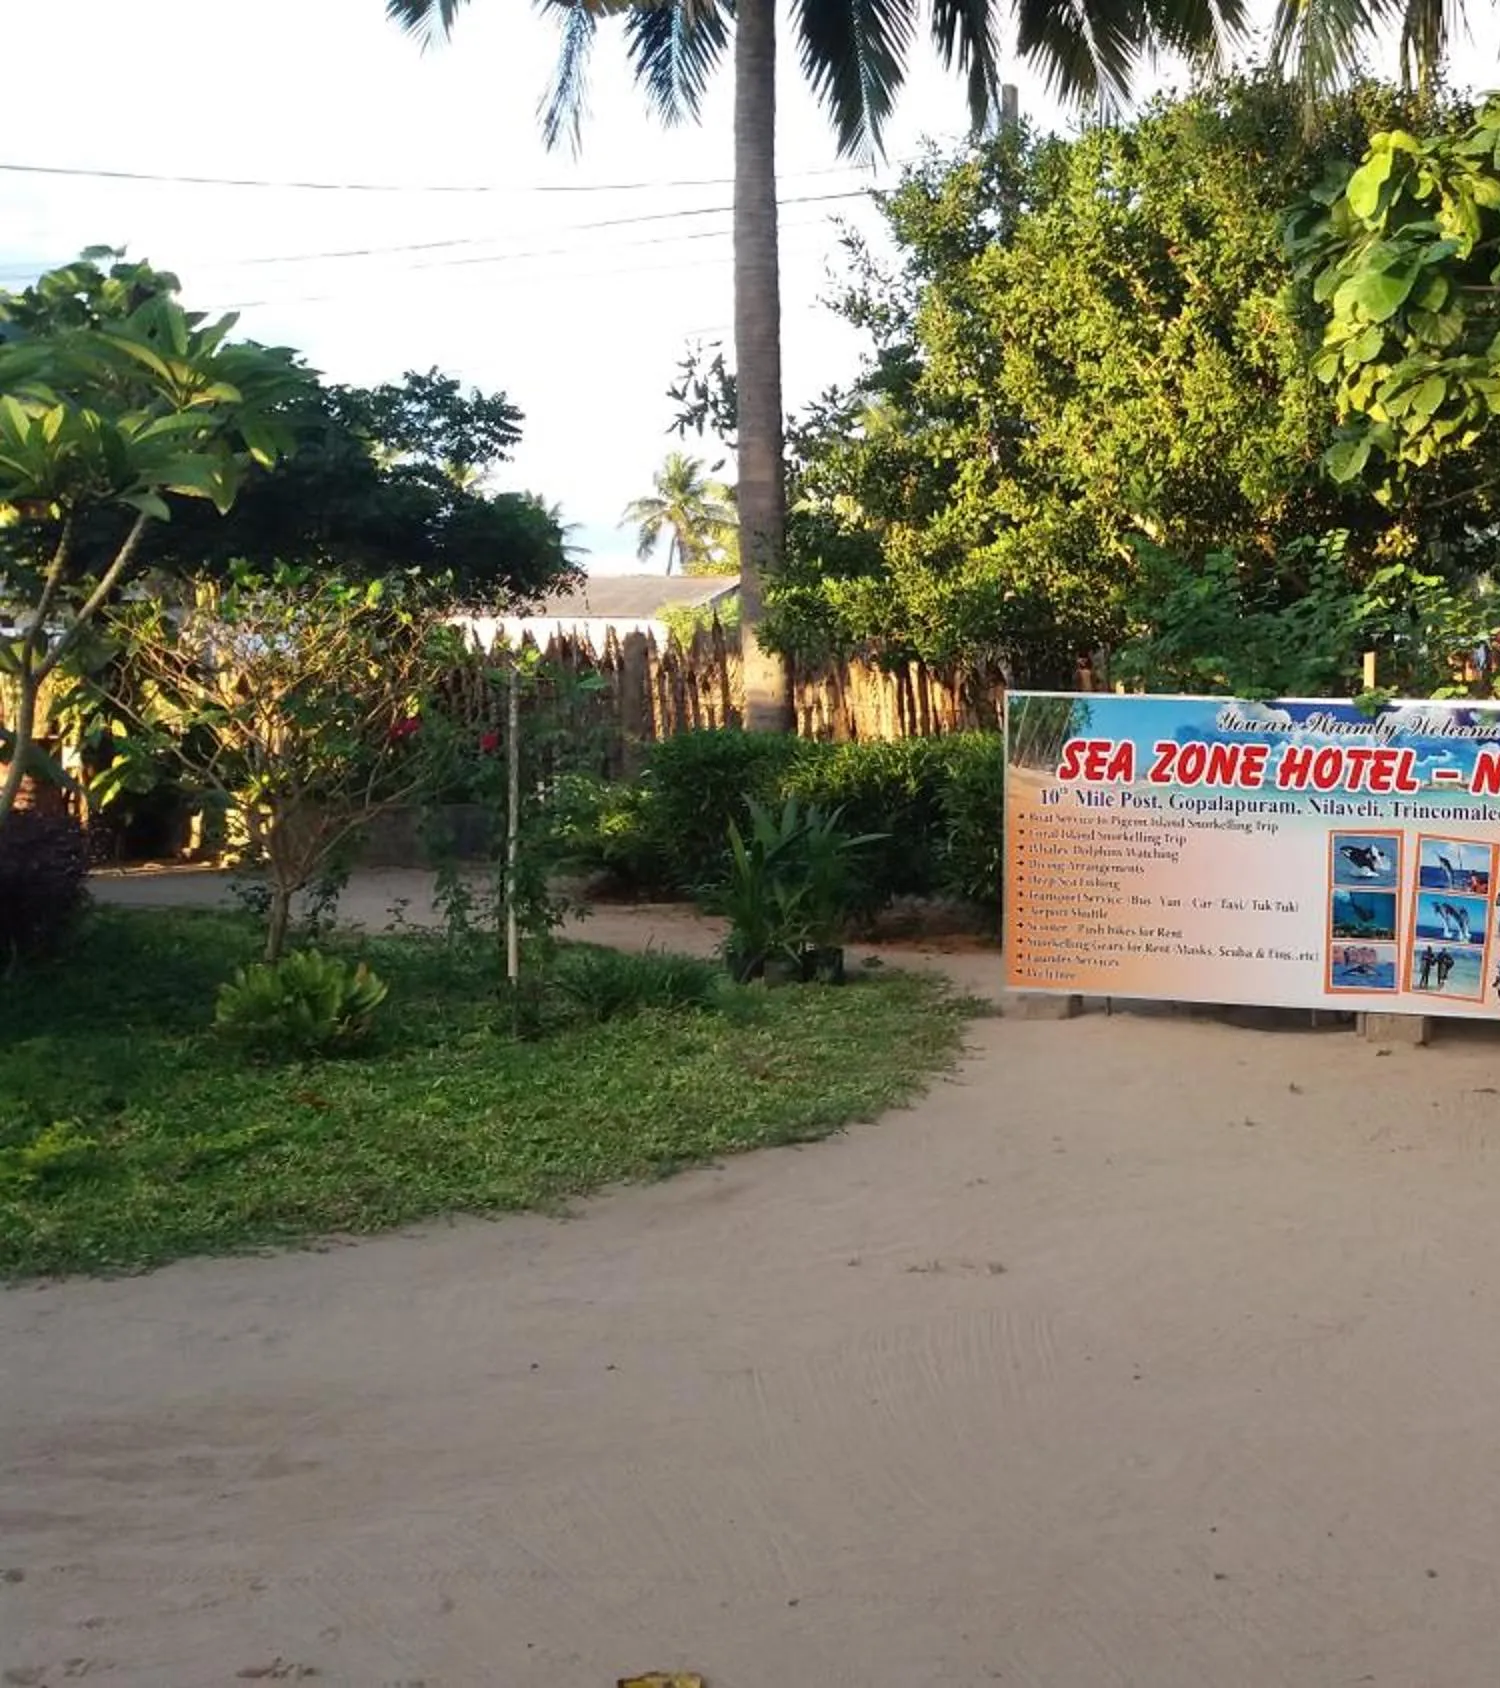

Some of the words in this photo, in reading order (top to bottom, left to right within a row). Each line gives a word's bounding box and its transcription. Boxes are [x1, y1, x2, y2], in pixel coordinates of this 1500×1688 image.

[1058, 739, 1134, 783] SEA
[1150, 743, 1269, 787] ZONE
[1278, 747, 1418, 792] HOTEL
[1076, 789, 1114, 808] Mile
[1256, 820, 1279, 835] Trip
[1164, 833, 1187, 847] Trip
